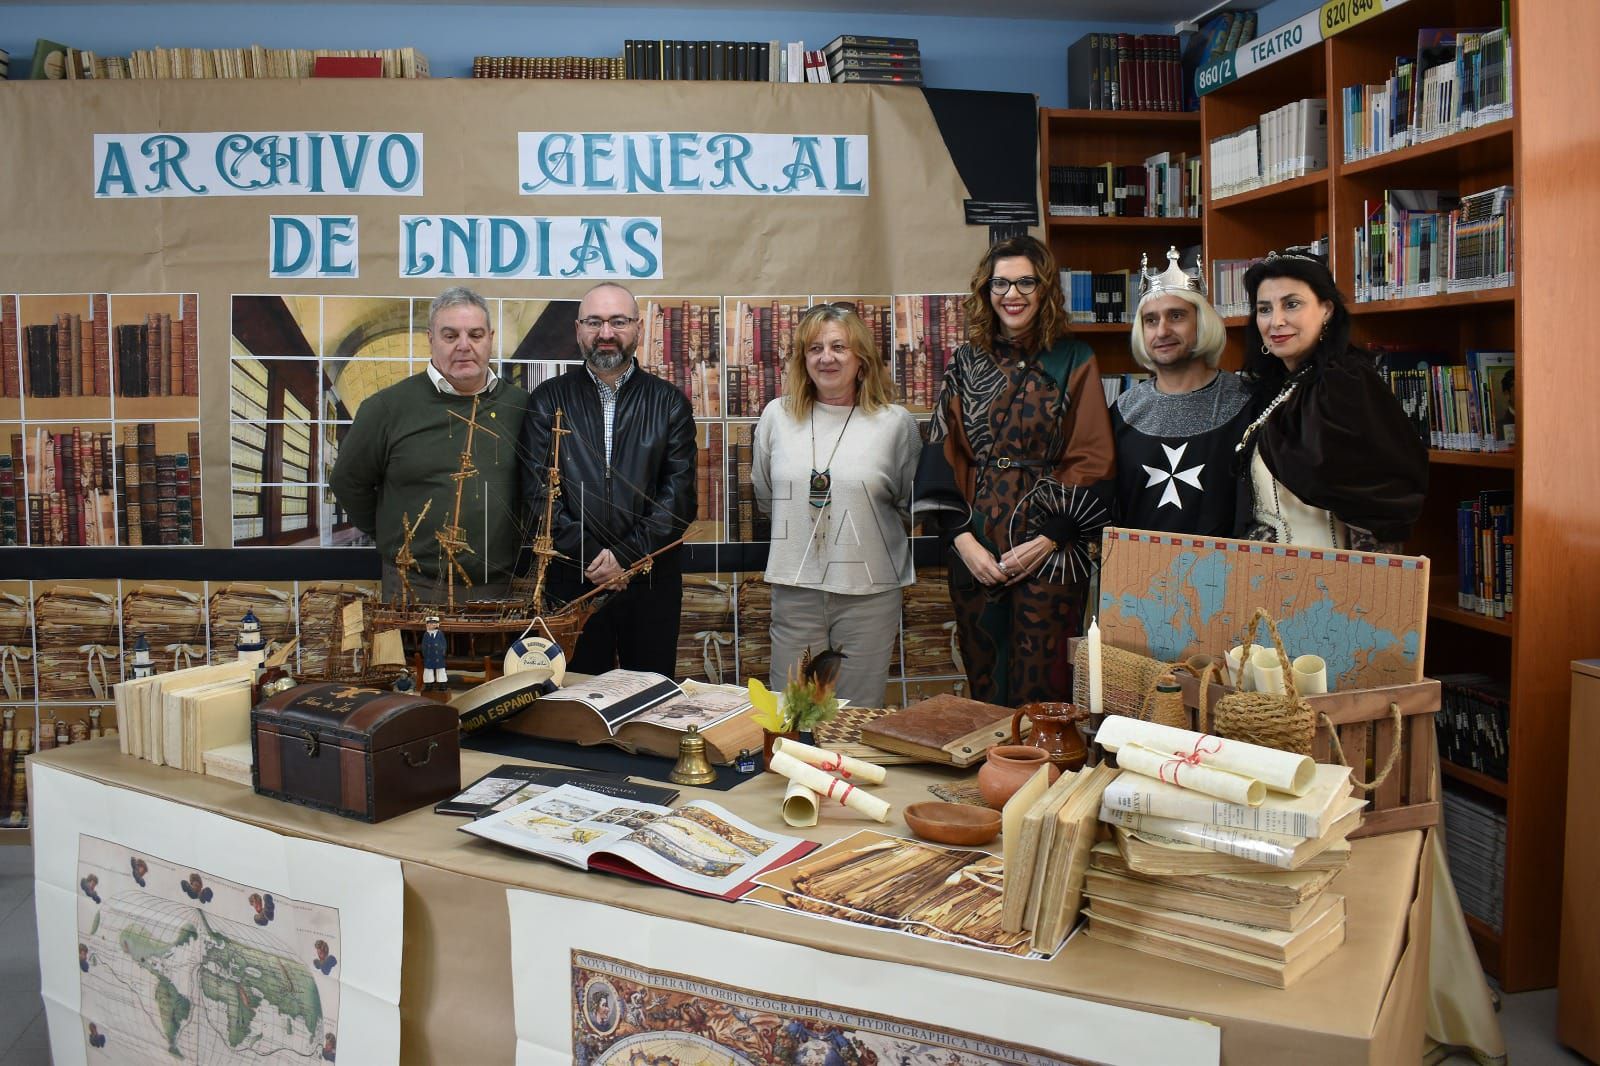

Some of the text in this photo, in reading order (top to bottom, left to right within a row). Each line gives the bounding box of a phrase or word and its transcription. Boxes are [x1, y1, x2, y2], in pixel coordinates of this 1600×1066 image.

[1199, 25, 1303, 89] 860/2 TEATRO
[95, 133, 865, 196] ARCHIVO GENERAL
[271, 216, 660, 278] DE INDIAS
[580, 956, 607, 972] NOVA
[610, 963, 644, 980] TOTIVS
[645, 973, 708, 995] TERRARVM
[710, 988, 744, 1003] ORBIS
[746, 996, 834, 1021] GEOGRAPHICA
[838, 1015, 853, 1024] AC
[857, 1017, 969, 1049] HYDROGRAPHICA
[974, 1042, 1030, 1063] TABVLA
